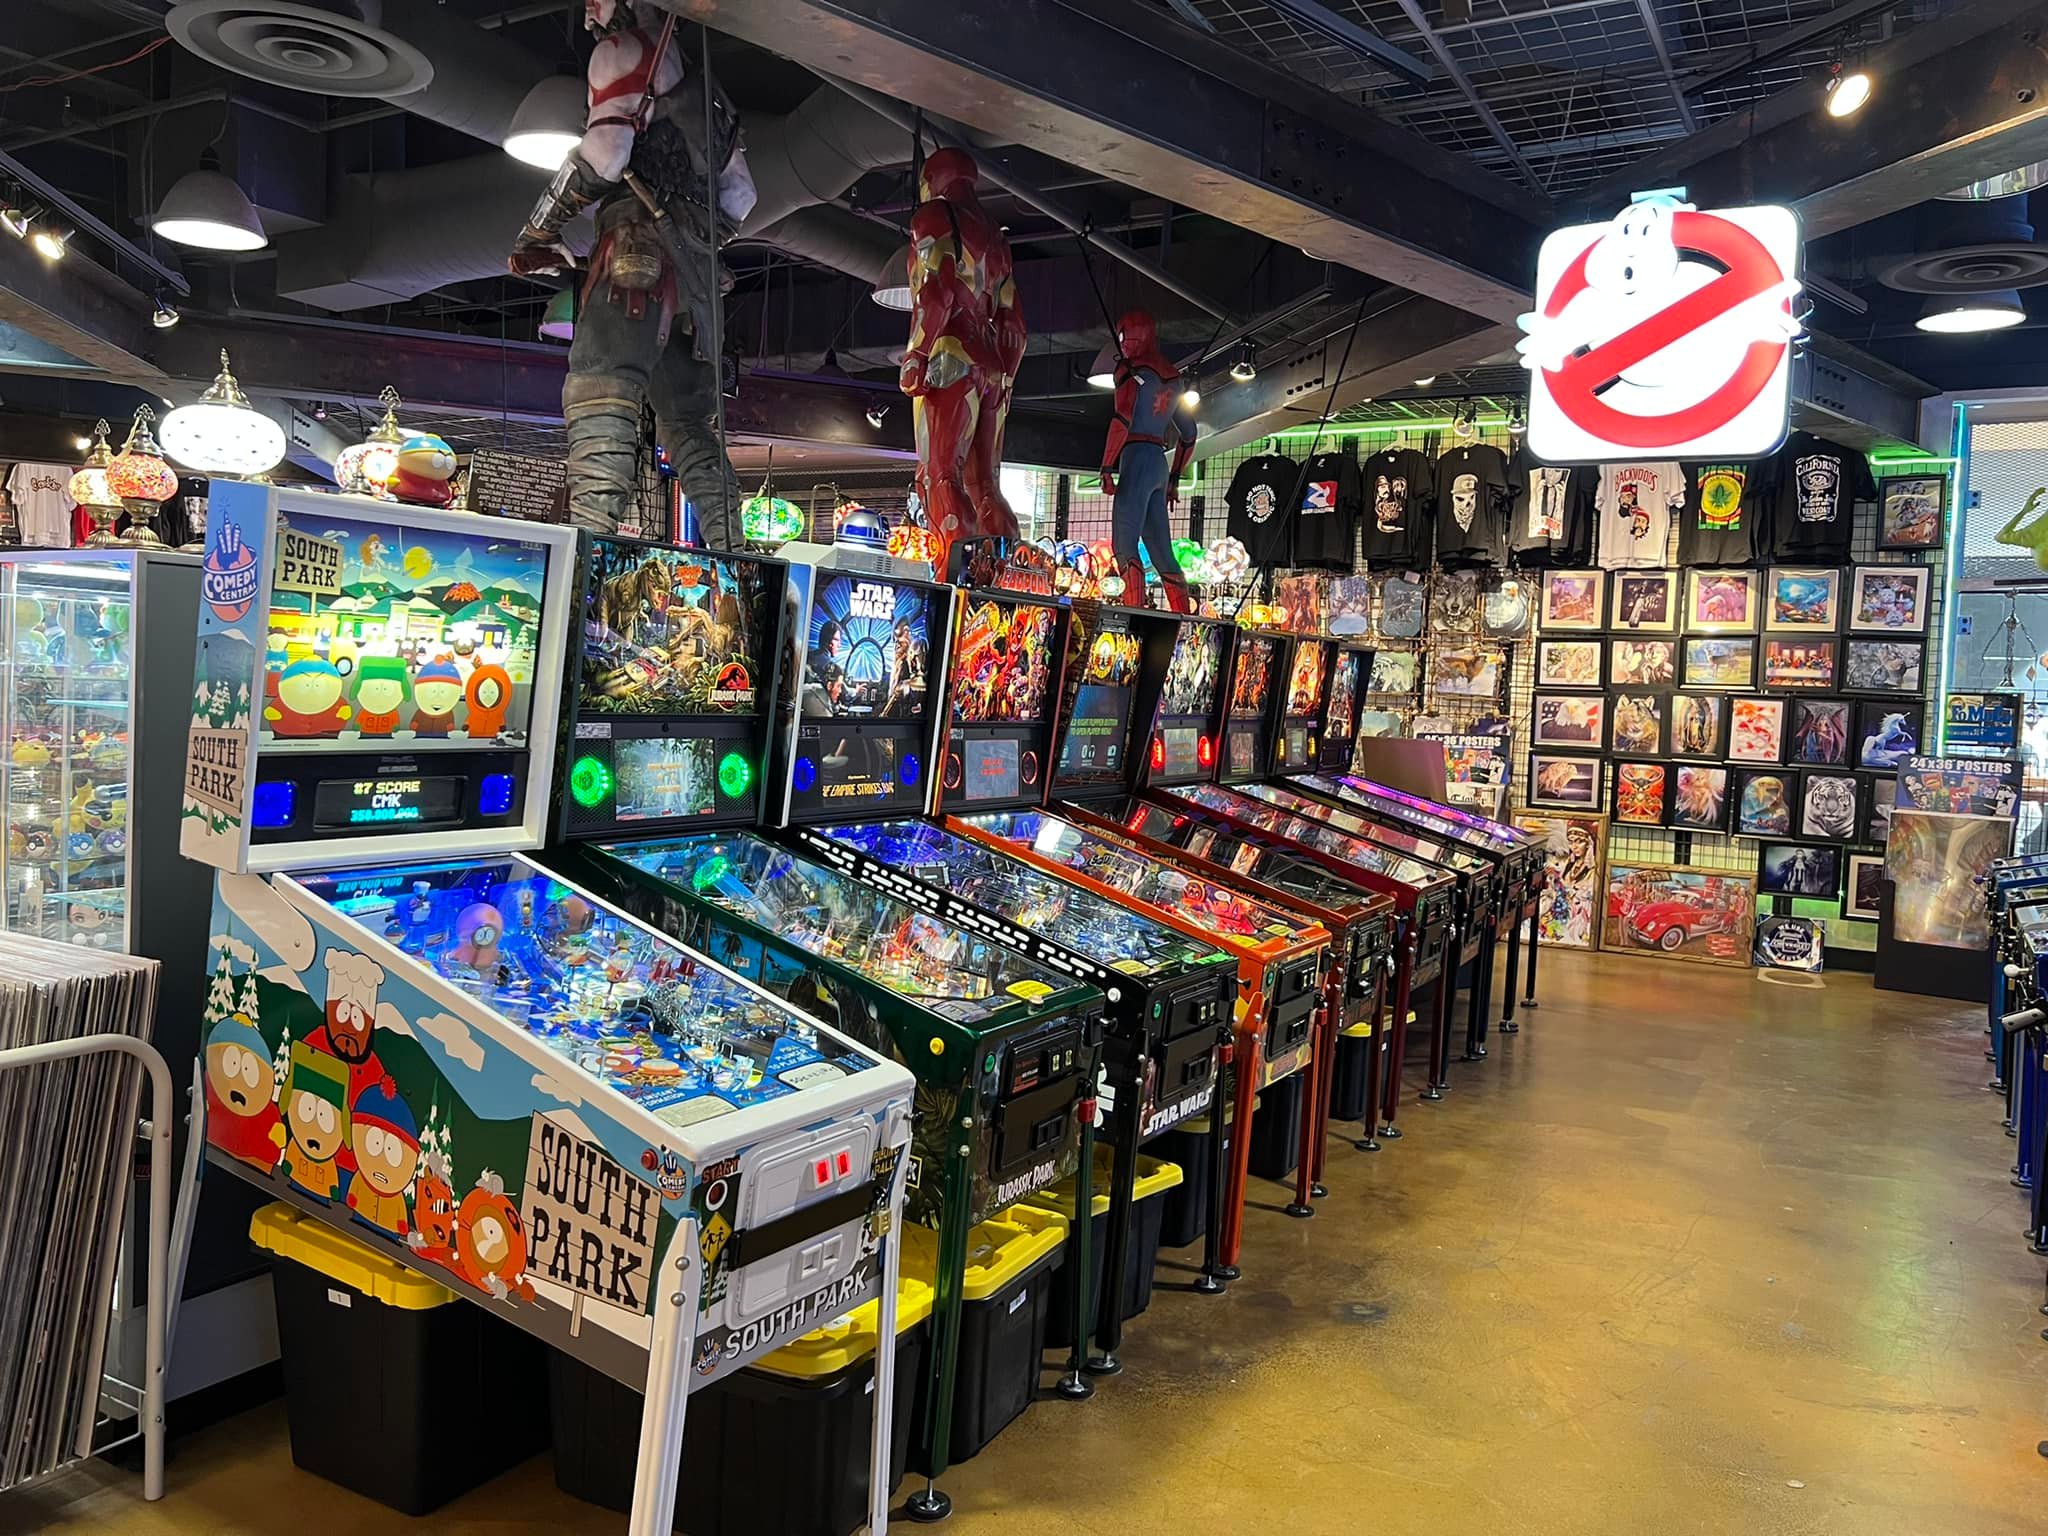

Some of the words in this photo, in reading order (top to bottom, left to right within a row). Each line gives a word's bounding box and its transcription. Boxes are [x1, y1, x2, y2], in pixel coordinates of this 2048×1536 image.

[489, 451, 524, 462] CHARACTERS
[538, 460, 557, 468] EVENTS
[1795, 457, 1839, 476] CALIFORNIA
[285, 534, 338, 567] SOUTH
[204, 566, 257, 599] COMEDY
[282, 560, 336, 588] PARK
[220, 584, 257, 600] CENTRAL
[850, 583, 896, 603] STAR
[850, 600, 895, 620] WARS
[193, 736, 238, 768] SOUTH
[1459, 736, 1502, 746] POSTERS
[1956, 760, 2012, 774] POSTERS
[191, 764, 236, 802] PARK
[376, 780, 421, 794] SCORE
[372, 794, 402, 808] CMK
[1142, 1104, 1179, 1136] STAR
[1180, 1085, 1216, 1118] WARS
[702, 1156, 740, 1184] START
[994, 1172, 1033, 1208] JURASSIC
[1032, 1160, 1056, 1190] PARK
[537, 1123, 650, 1247] SOUTH
[527, 1206, 642, 1309] PARK
[726, 1299, 806, 1360] SOUTH
[812, 1265, 870, 1317] PARK
